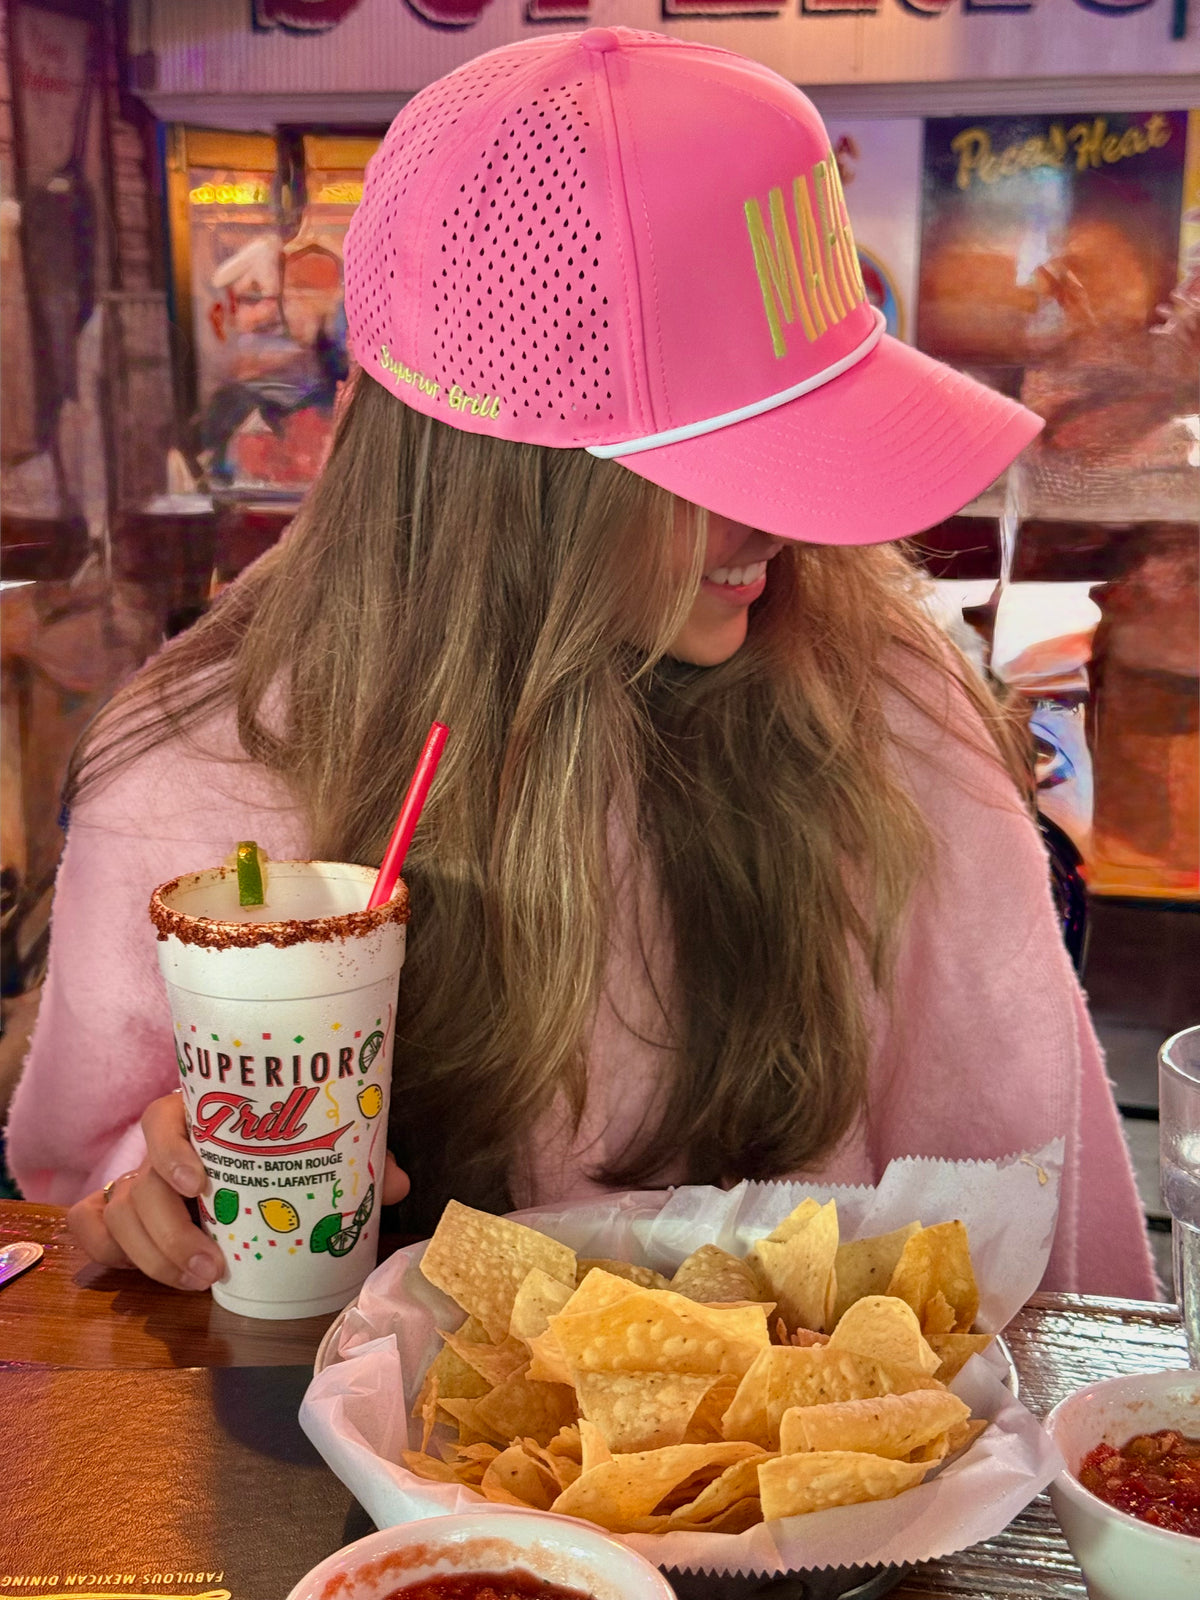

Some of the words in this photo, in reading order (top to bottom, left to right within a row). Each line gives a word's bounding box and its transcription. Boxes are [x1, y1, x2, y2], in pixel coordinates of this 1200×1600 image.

[1066, 115, 1171, 171] Heat
[380, 344, 440, 399] Superior
[448, 384, 500, 420] Grill
[184, 1042, 355, 1087] SUPERIOR
[192, 1086, 355, 1156] Grill
[200, 1147, 256, 1171] SHREVEPORT
[264, 1159, 303, 1172] BATON
[305, 1152, 343, 1169] ROUGE
[222, 1171, 269, 1188] ORLEANS
[277, 1170, 337, 1188] LAFAYETTE
[1, 1575, 59, 1587] DINING
[65, 1574, 137, 1586] MEXICAN
[142, 1571, 225, 1586] FABULOUS
